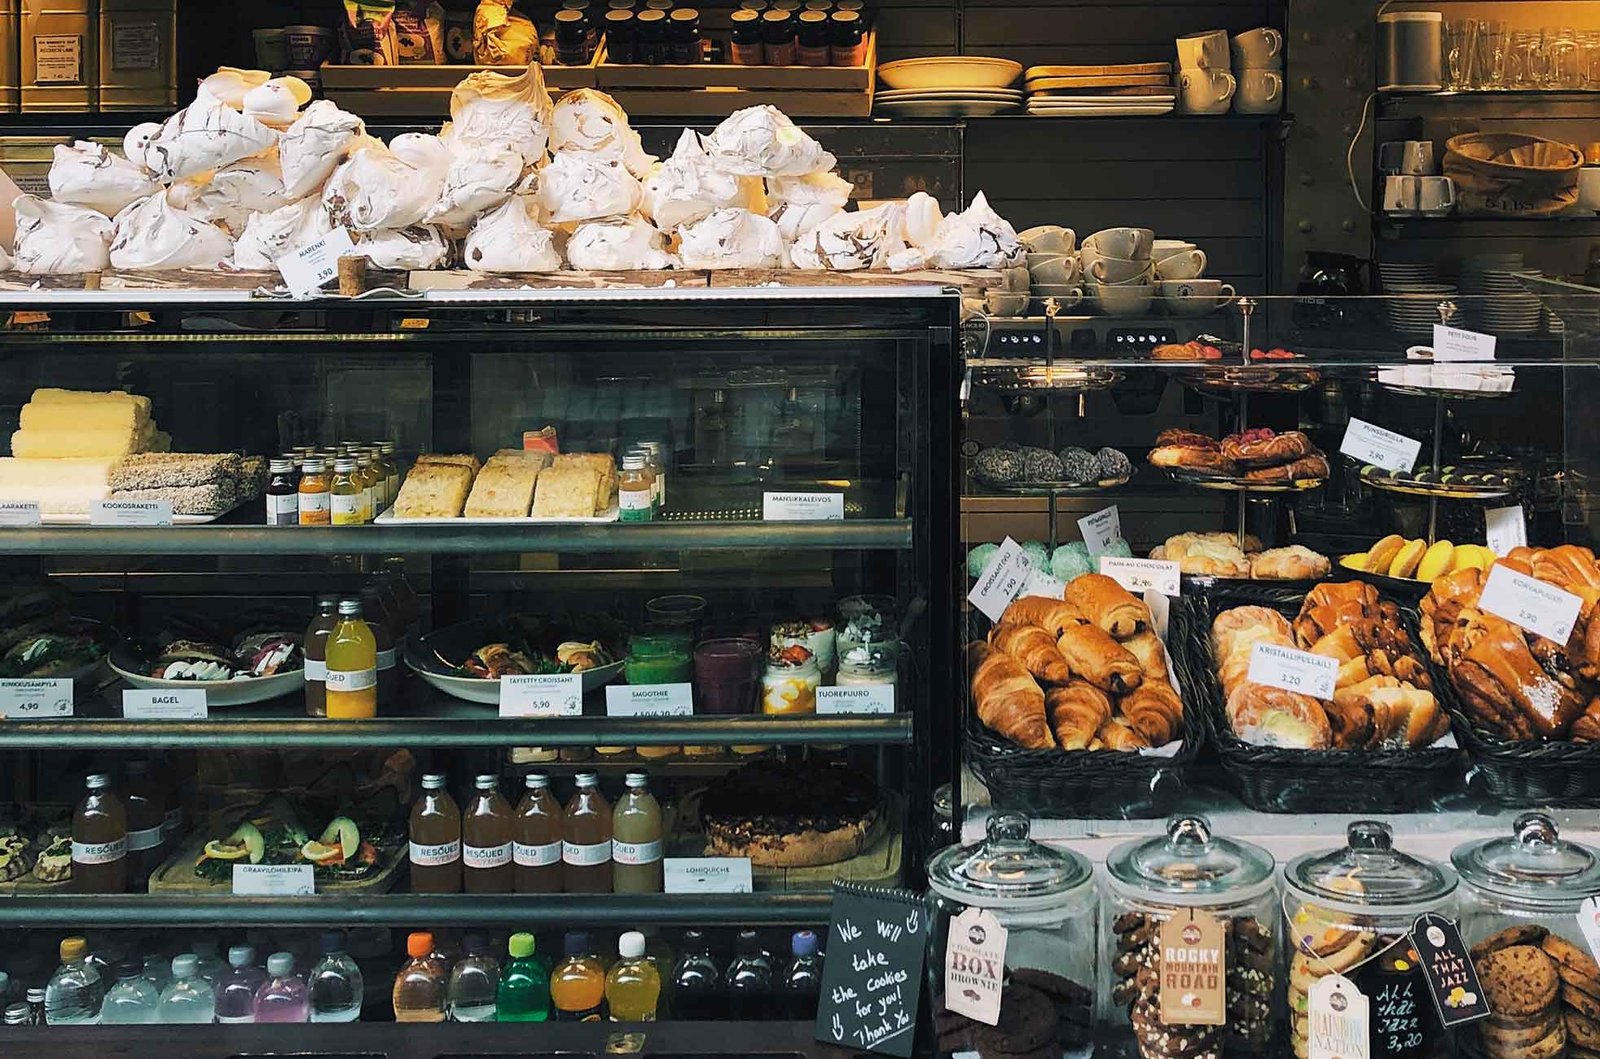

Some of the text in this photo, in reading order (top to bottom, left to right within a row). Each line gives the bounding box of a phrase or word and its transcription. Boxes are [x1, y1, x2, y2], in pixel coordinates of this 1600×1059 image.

[298, 240, 326, 257] MARENKI
[317, 267, 334, 281] 3,90
[102, 502, 159, 510] KOOKOSRAKETTI
[151, 696, 180, 704] BAGEL
[632, 690, 669, 698] SMOOTHIE
[818, 690, 870, 698] TUOREPUURO
[19, 702, 39, 711] 4,90
[532, 700, 551, 710] 5,90
[421, 843, 459, 857] RESCUED
[466, 848, 503, 859] RESCUED
[837, 919, 861, 942] We
[852, 949, 889, 972] take
[1165, 948, 1219, 962] ROCKY
[1434, 949, 1456, 962] ALL
[952, 952, 997, 980] BOX
[1165, 962, 1218, 973] MOUNTAIN
[1431, 958, 1464, 975] THAT
[832, 970, 908, 1004] the cookies
[951, 972, 998, 991] BROWNIE
[1166, 974, 1217, 989] ROAD
[1441, 972, 1469, 988] JAZZ
[856, 984, 902, 1018] for you!
[853, 1017, 892, 1045] Thank
[1387, 1032, 1423, 1052] 3,20
